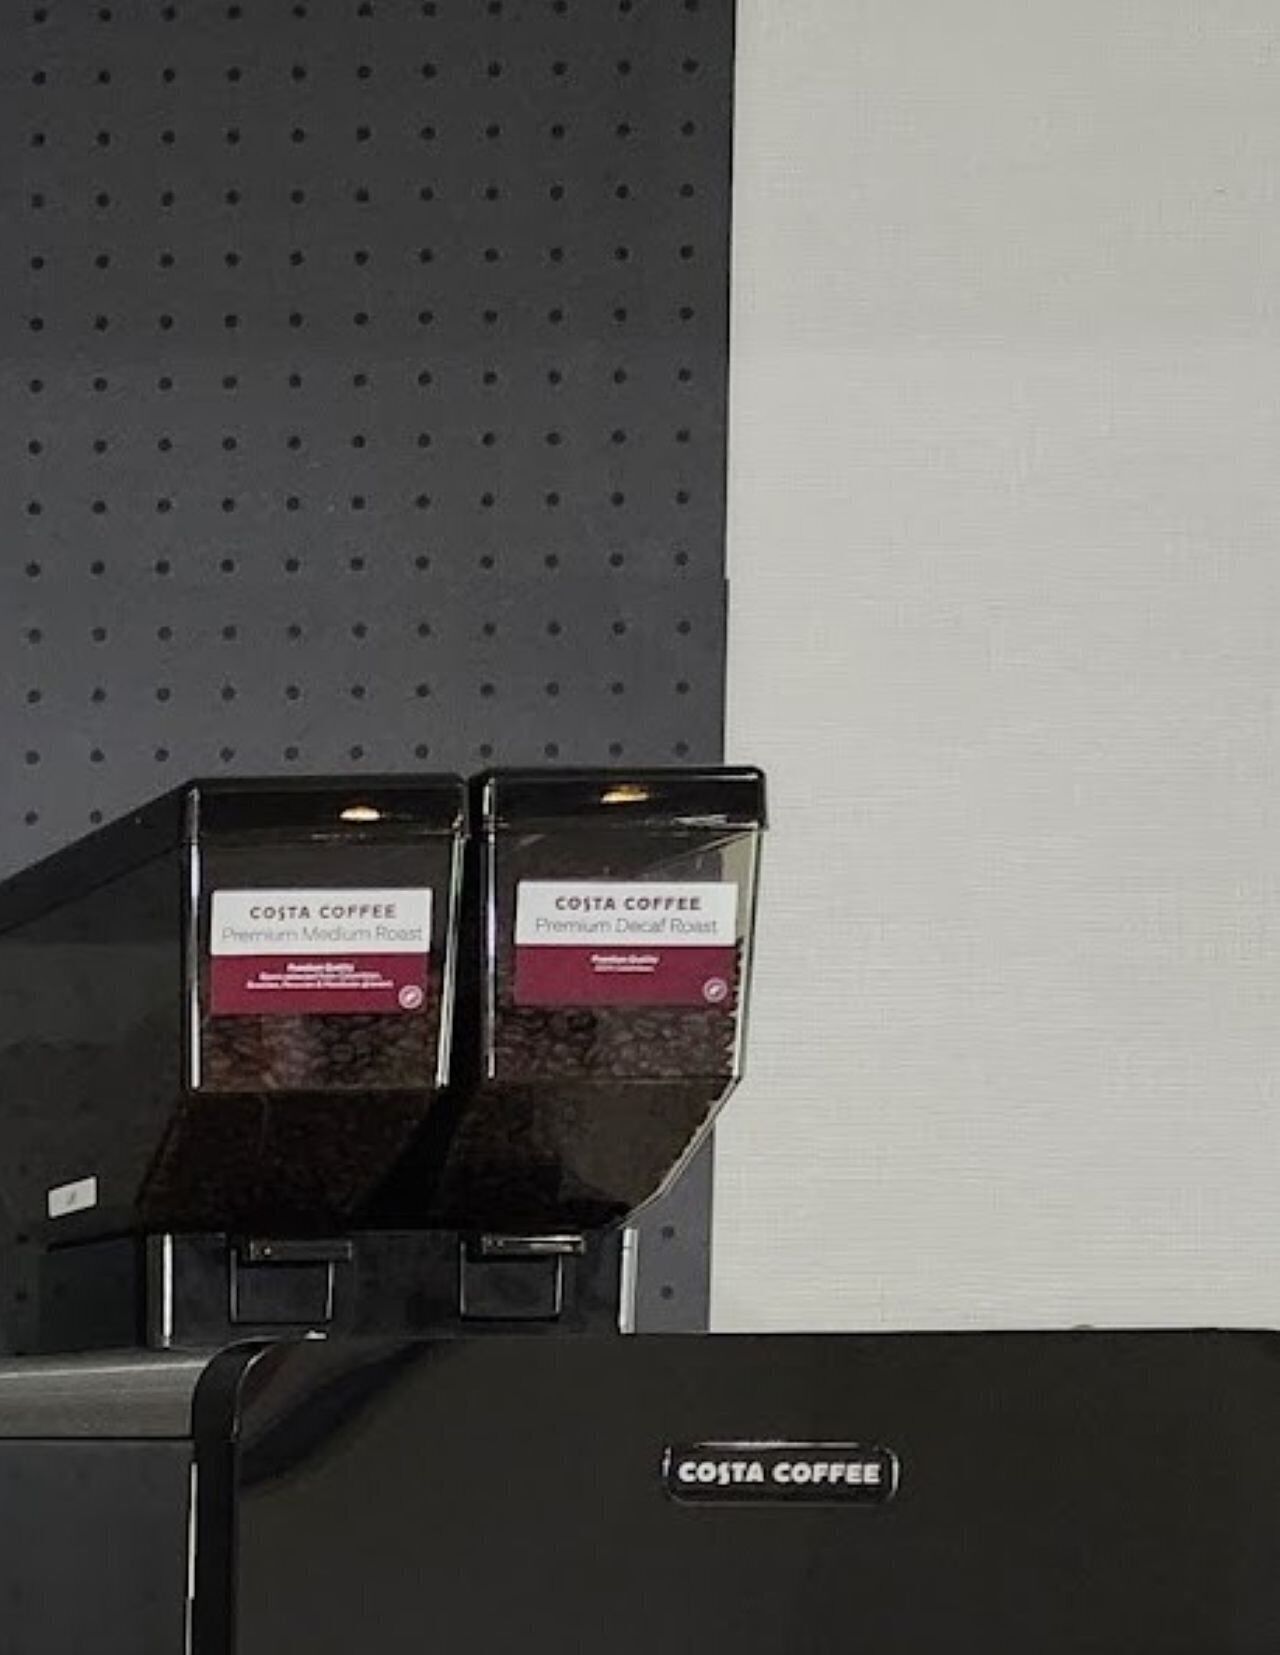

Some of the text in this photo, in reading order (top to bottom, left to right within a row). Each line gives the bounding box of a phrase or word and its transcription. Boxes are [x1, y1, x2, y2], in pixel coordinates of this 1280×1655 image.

[250, 903, 397, 921] COSTA COFFEE
[555, 896, 701, 912] COSTA COFFEE
[222, 924, 423, 943] Premium Medium Roast
[536, 917, 717, 934] Premium Decaf Roast
[678, 1461, 881, 1486] COSTA COFFEE
